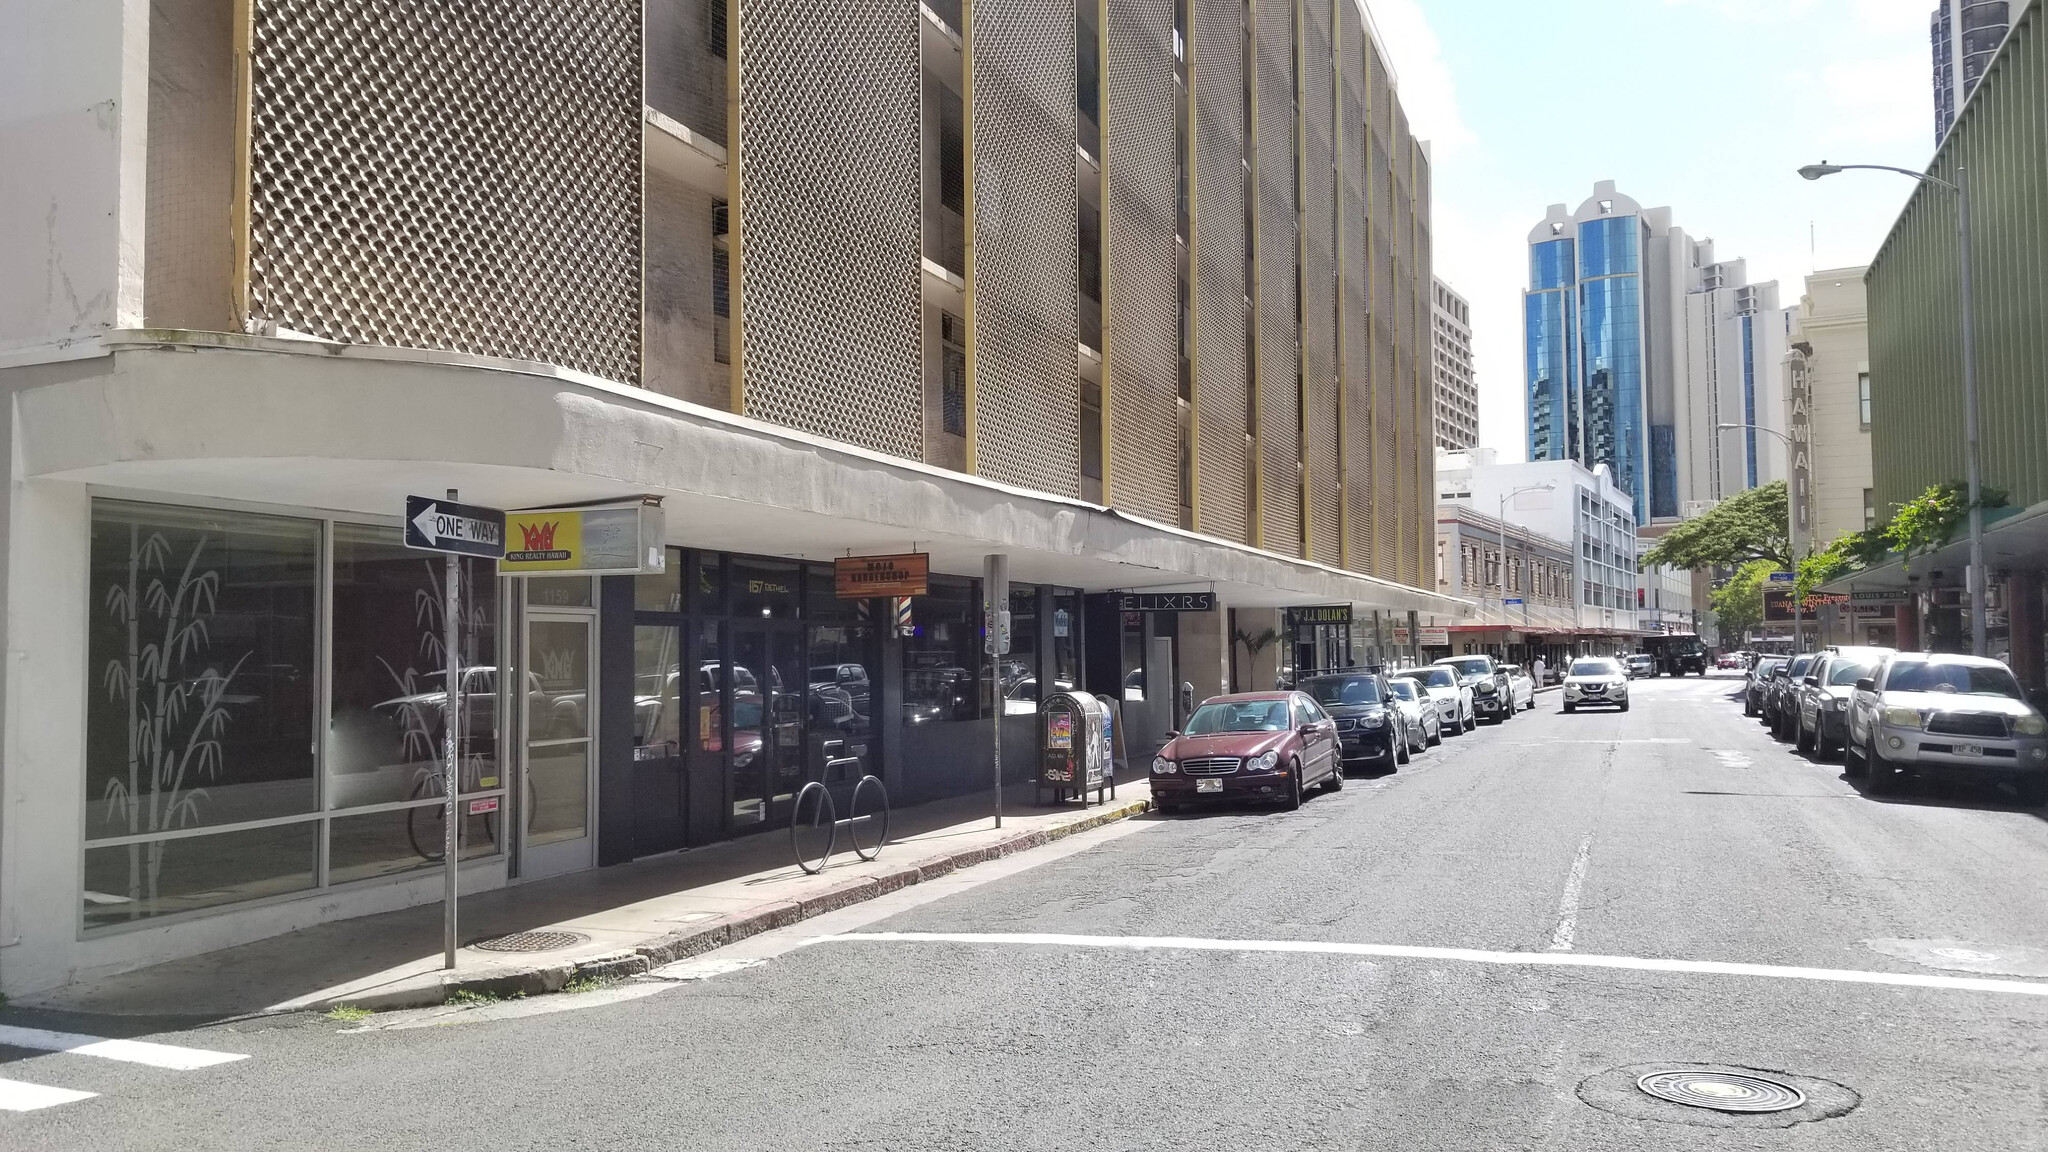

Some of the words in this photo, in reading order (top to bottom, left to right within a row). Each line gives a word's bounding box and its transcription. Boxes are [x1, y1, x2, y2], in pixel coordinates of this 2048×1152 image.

[1792, 370, 1808, 524] HAWAII
[436, 515, 463, 537] ONE
[470, 520, 496, 542] WAY
[525, 552, 545, 560] REALTY
[547, 551, 567, 559] HAWAII
[867, 561, 894, 571] MOJO
[851, 571, 910, 582] BARBERSHOP
[764, 583, 790, 593] BETHEL
[1123, 595, 1209, 610] ELIXRS
[1317, 608, 1348, 621] DOLAN'S
